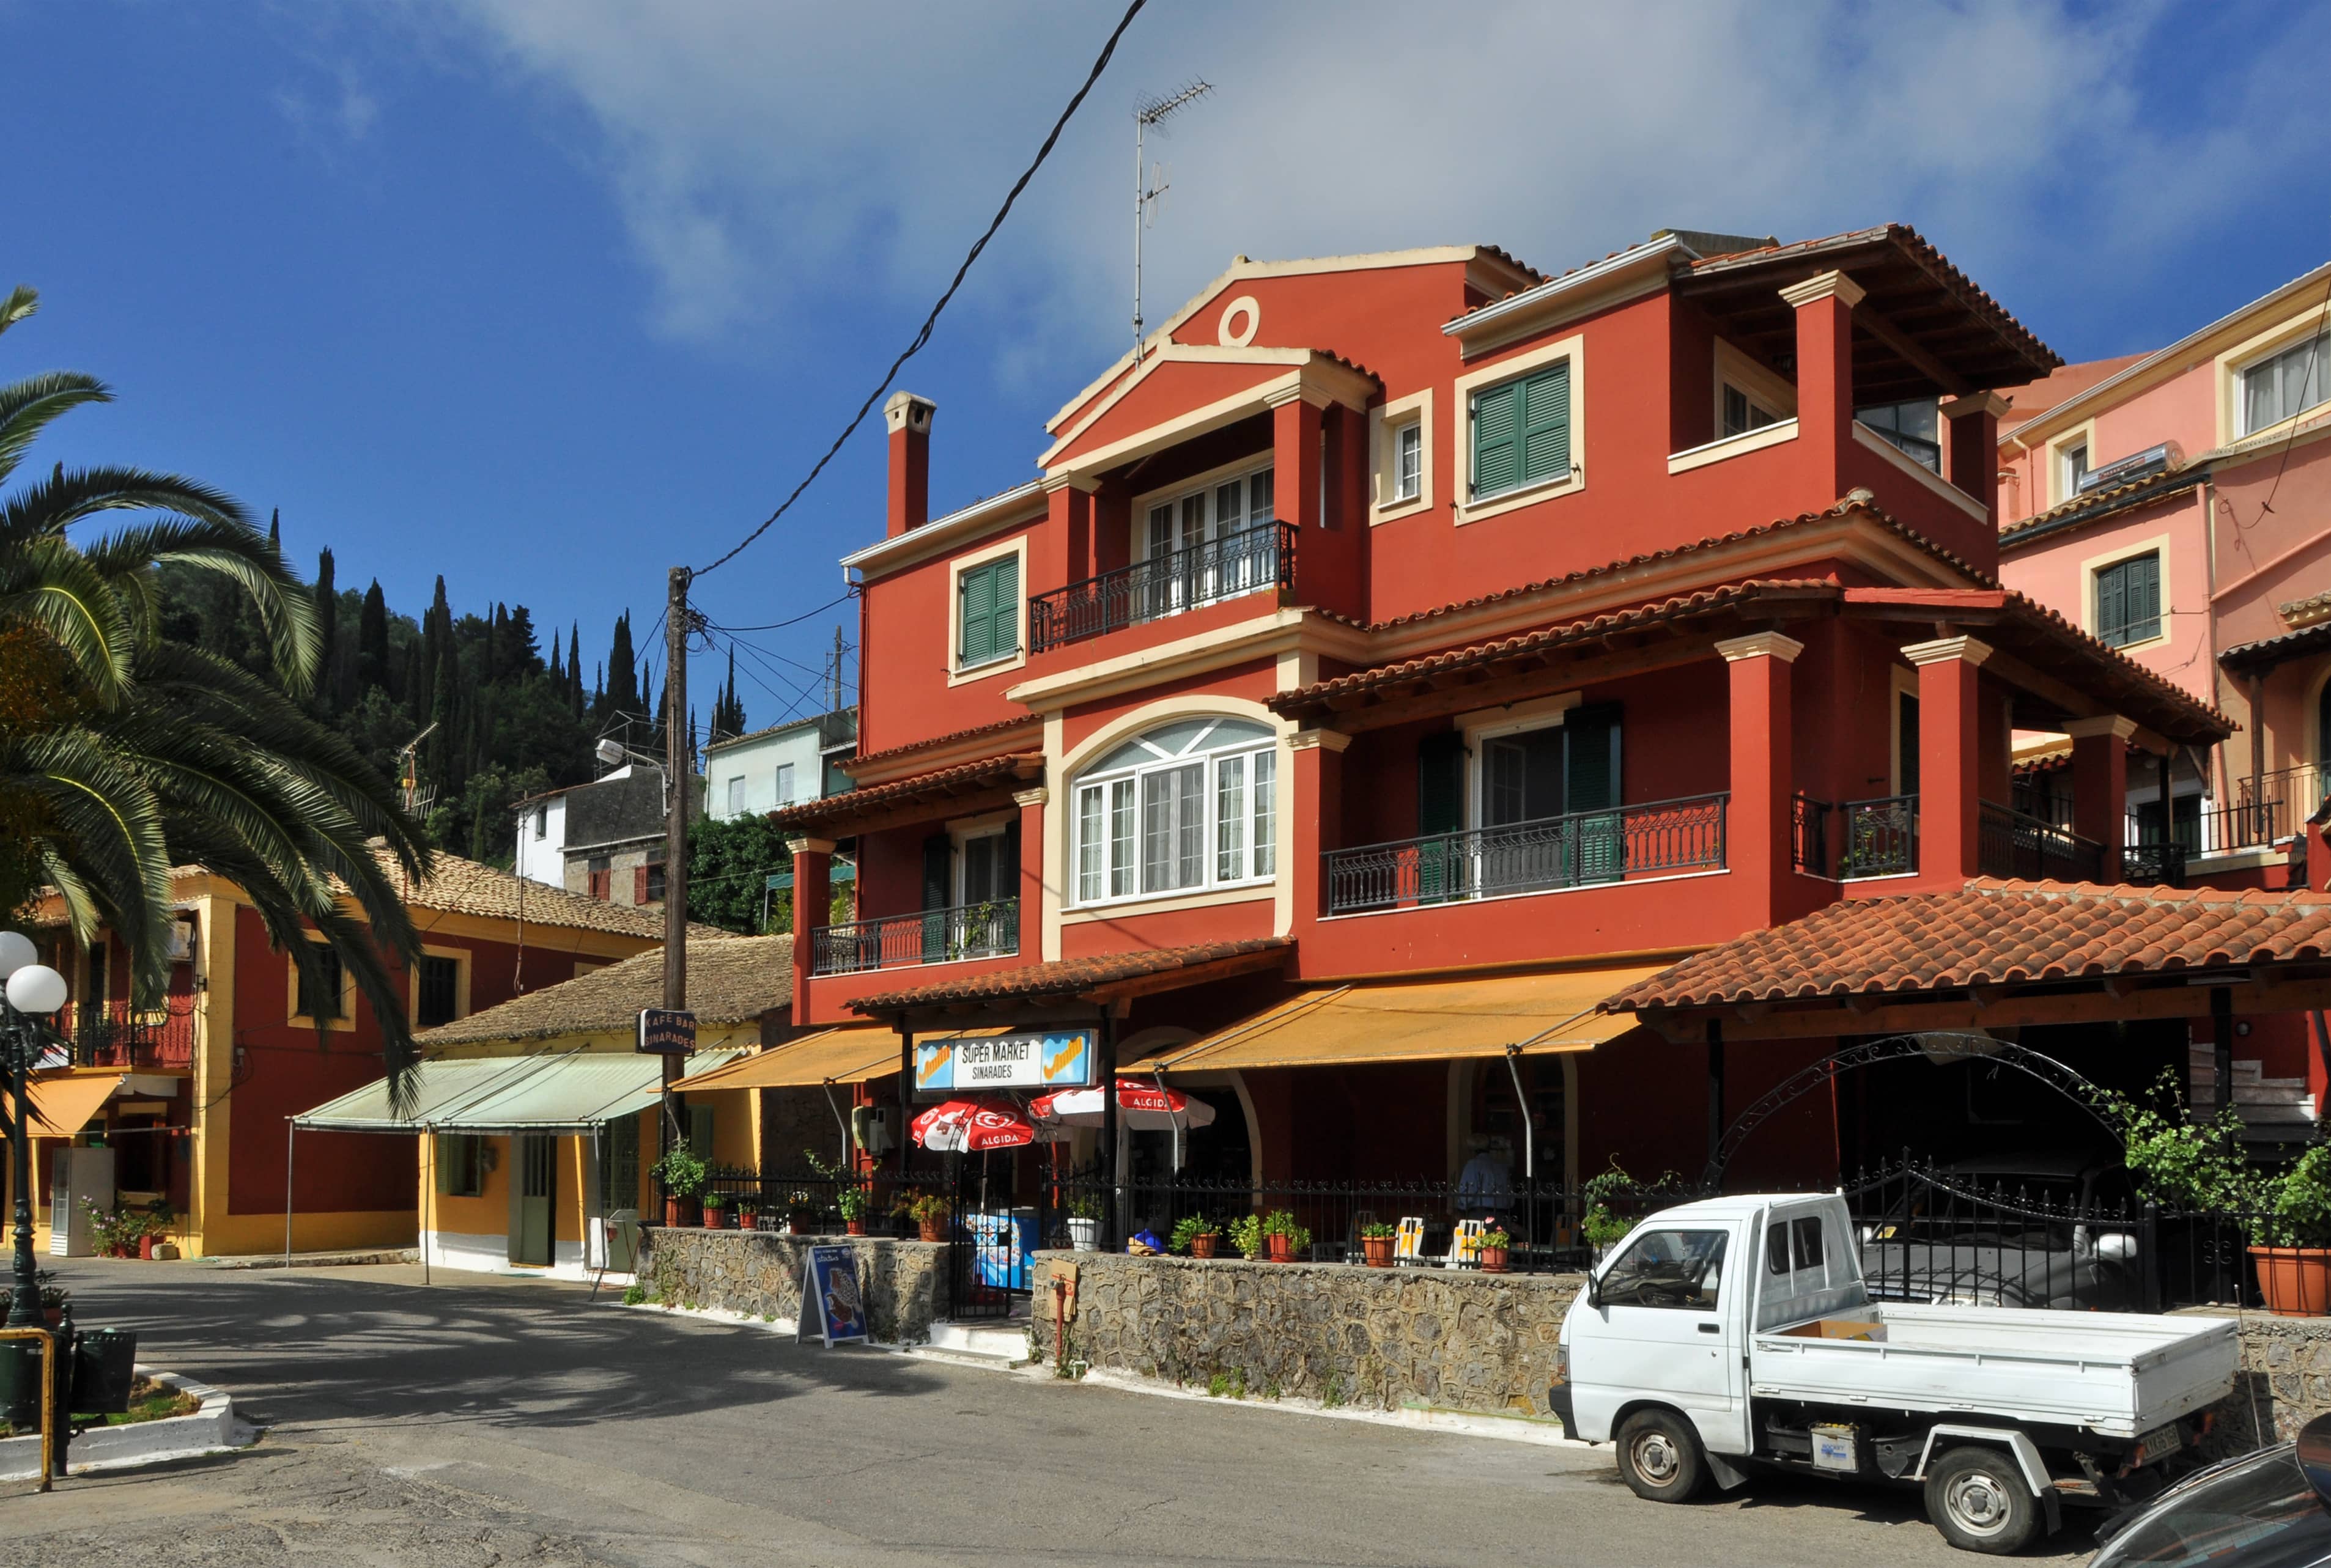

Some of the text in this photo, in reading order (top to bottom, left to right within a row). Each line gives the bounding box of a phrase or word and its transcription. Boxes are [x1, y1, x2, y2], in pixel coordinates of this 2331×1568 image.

[645, 1013, 695, 1031] KAFE BAR
[645, 1031, 696, 1050] SINARADES
[962, 1042, 1030, 1064] SUPER MARKET
[972, 1065, 1012, 1080] SINARADES
[981, 1134, 1019, 1146] ALGIDA
